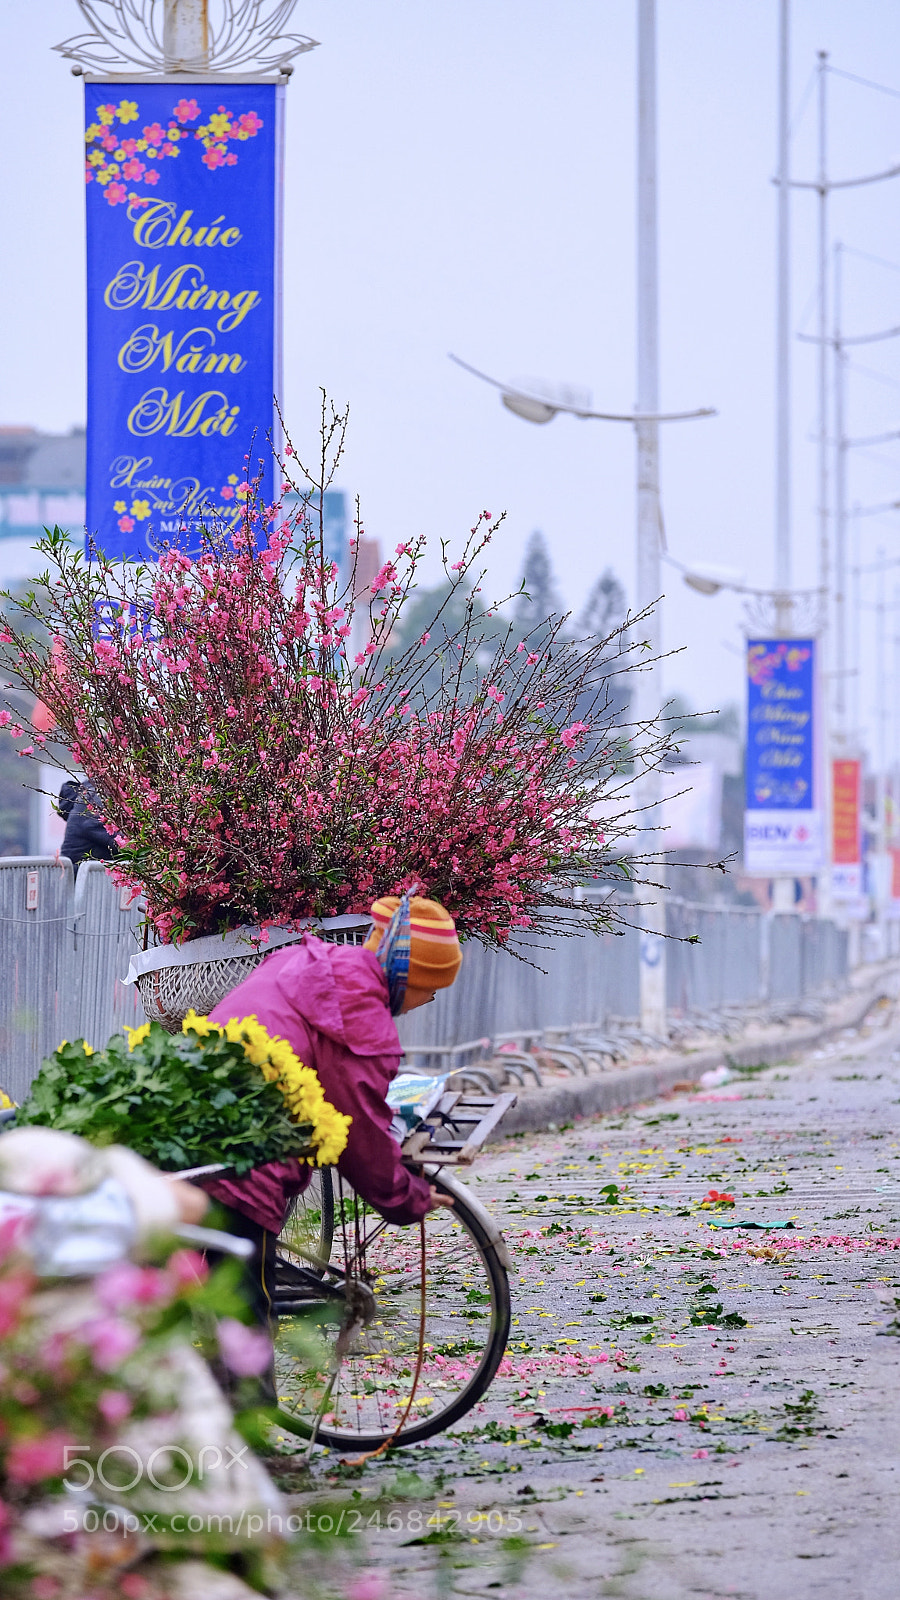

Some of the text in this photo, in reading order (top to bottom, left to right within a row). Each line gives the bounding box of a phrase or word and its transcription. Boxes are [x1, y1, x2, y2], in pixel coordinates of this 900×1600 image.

[126, 197, 243, 250] Chúc
[104, 260, 262, 333] Mừng
[117, 323, 248, 374] Năm
[127, 386, 241, 438] Mới
